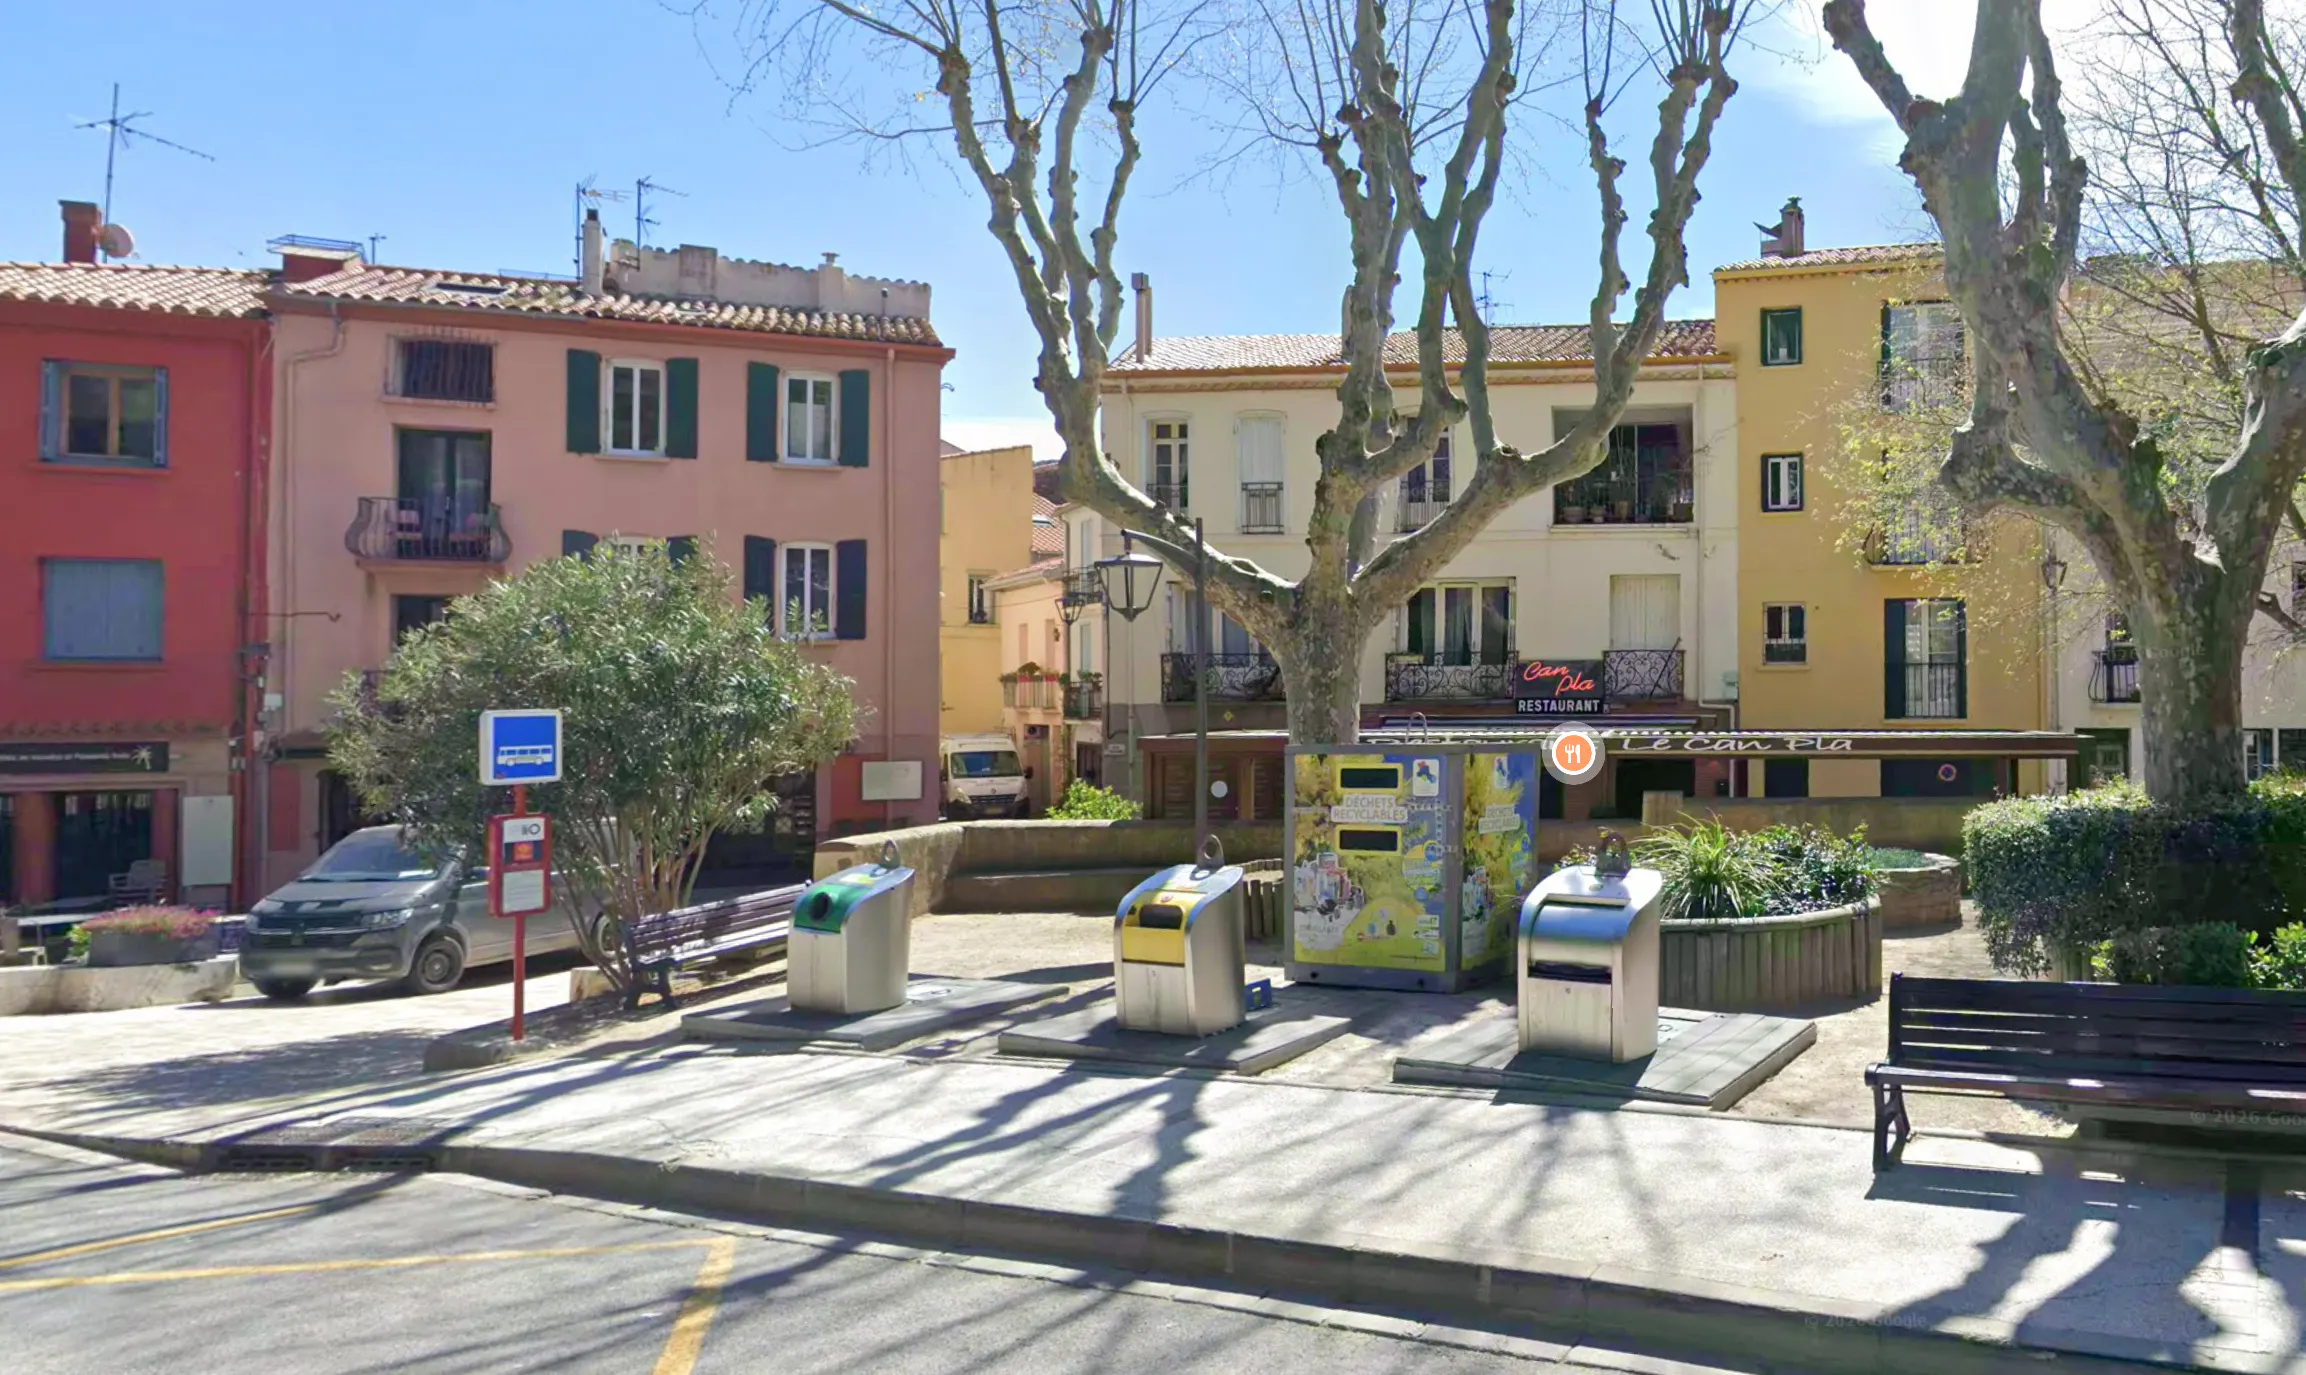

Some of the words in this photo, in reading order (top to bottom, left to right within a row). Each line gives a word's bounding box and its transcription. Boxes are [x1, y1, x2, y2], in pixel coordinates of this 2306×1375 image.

[1523, 661, 1570, 682] Can
[1518, 699, 1600, 712] RESTAURANT
[1622, 737, 1671, 751] Le
[1333, 808, 1406, 820] RECYCLABLES
